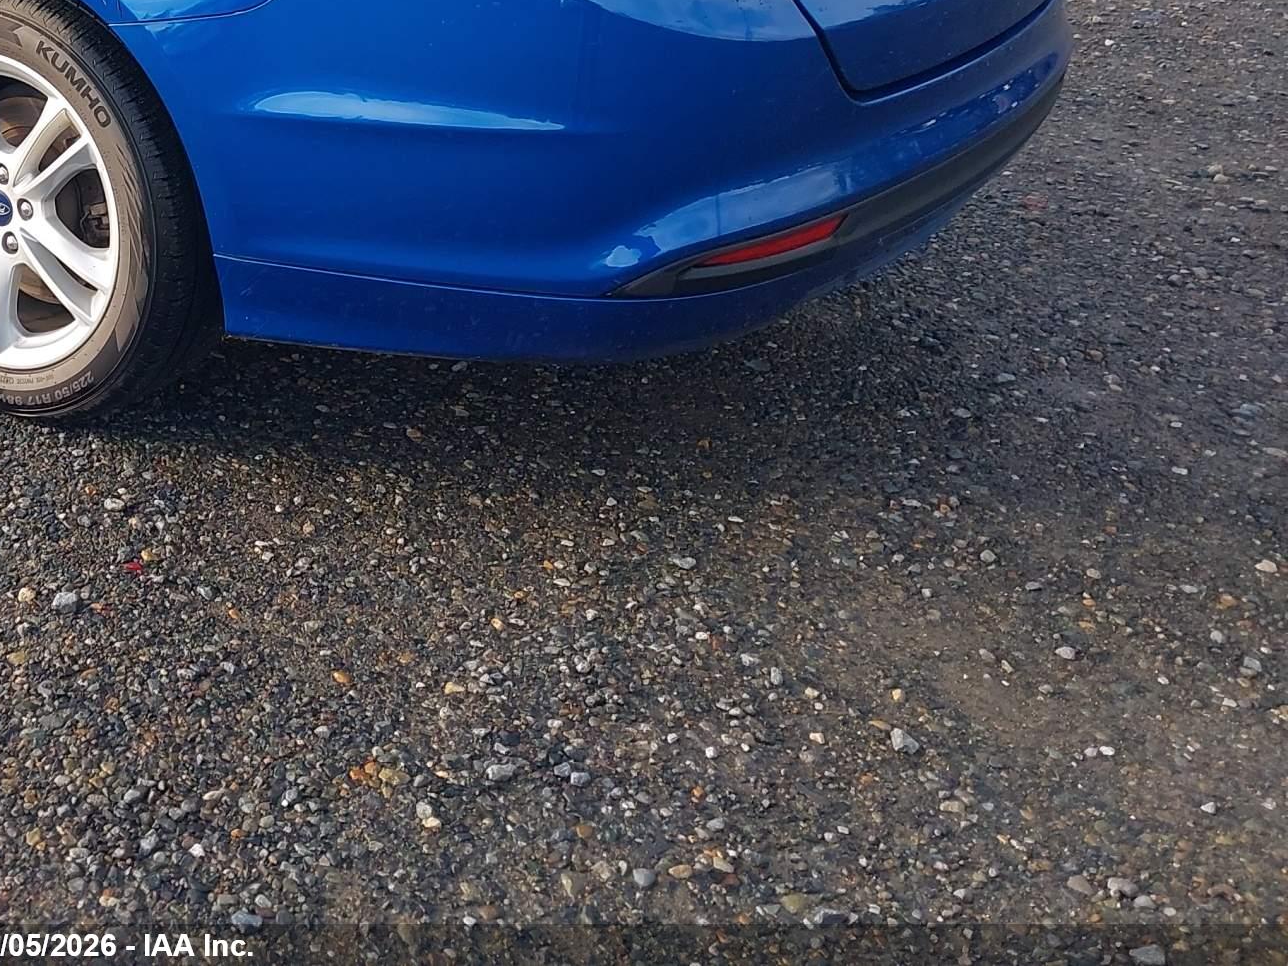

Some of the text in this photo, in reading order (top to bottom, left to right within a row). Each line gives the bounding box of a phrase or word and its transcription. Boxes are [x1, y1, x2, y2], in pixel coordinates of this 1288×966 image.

[36, 40, 111, 128] KUMHO
[27, 392, 51, 405] R17
[54, 371, 94, 400] 225/50
